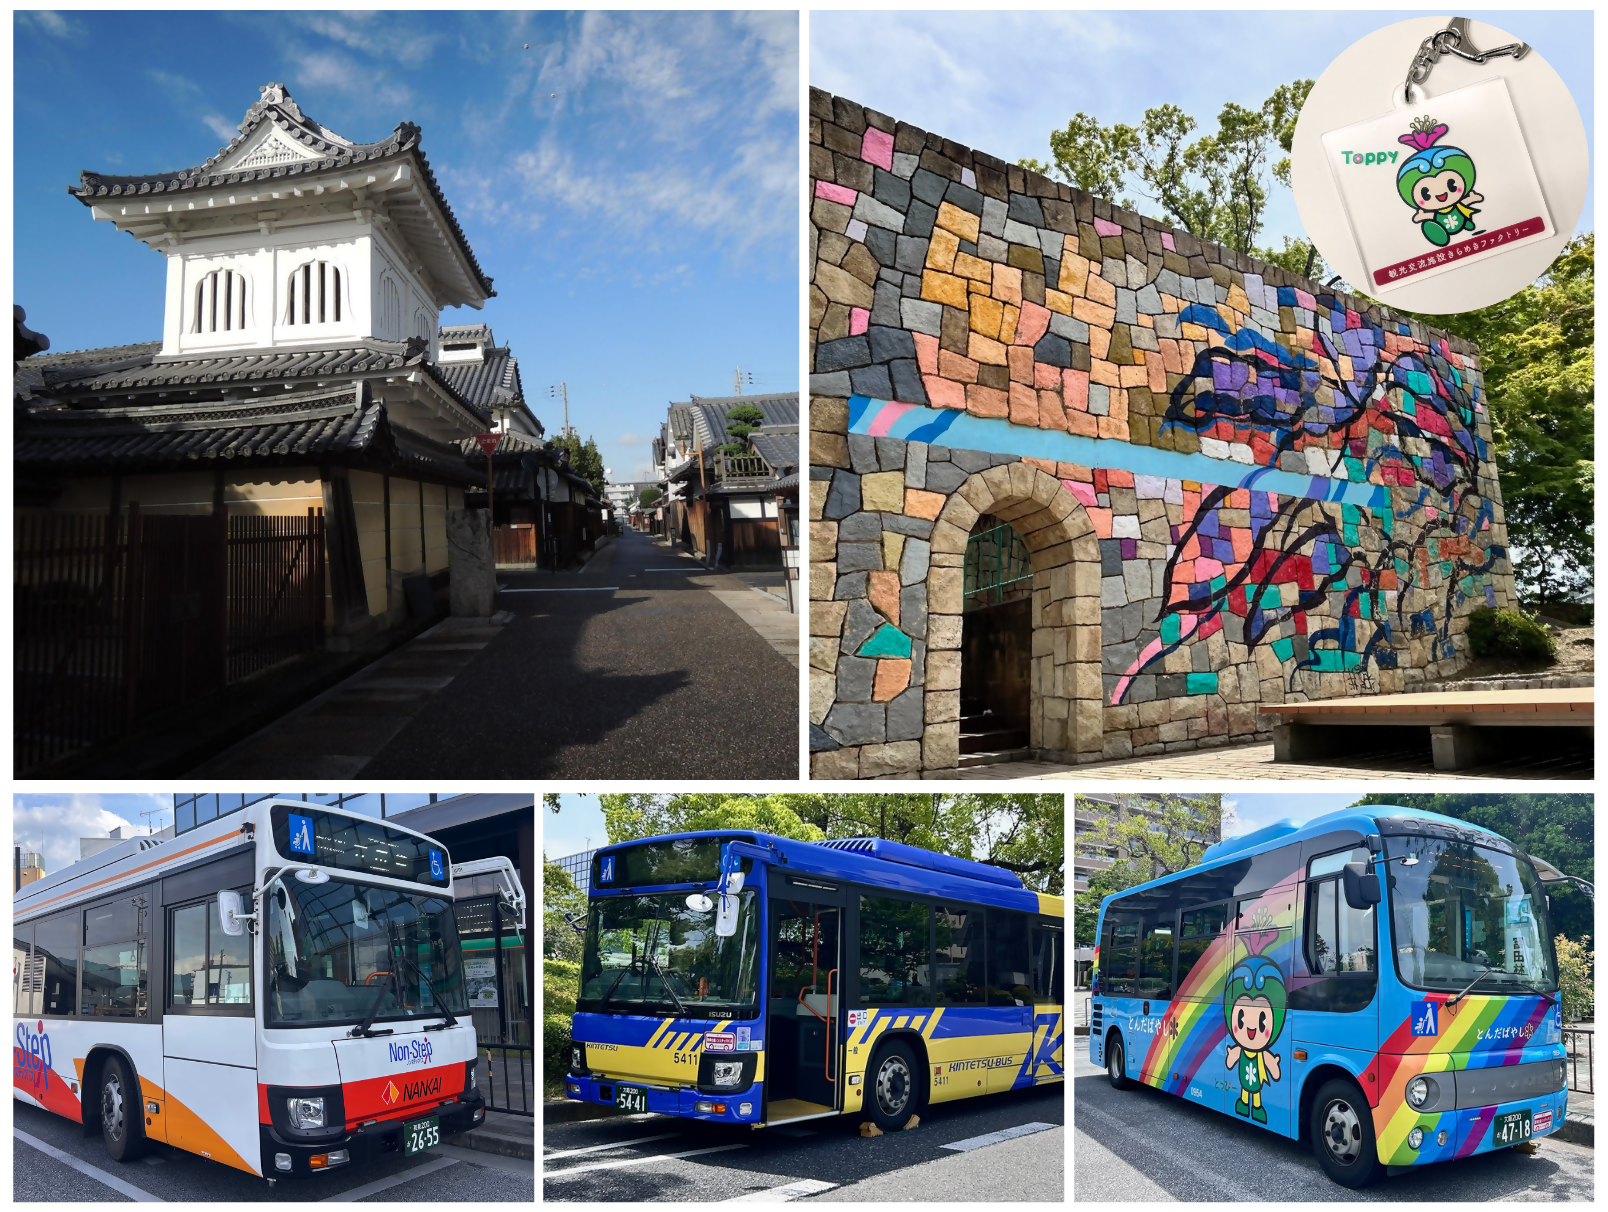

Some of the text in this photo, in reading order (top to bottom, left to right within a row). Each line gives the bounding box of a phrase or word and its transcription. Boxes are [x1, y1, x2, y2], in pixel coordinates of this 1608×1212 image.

[1341, 151, 1399, 166] Toppy
[1388, 227, 1529, 279] 観光交流施設きらめきファクトリー
[1128, 1016, 1169, 1037] とんだばやし
[1476, 1025, 1525, 1040] とんだばやし
[388, 1037, 433, 1064] Non-Step
[586, 1042, 619, 1052] KINTETSU
[673, 1052, 698, 1066] 5411
[933, 1076, 949, 1087] 5411
[403, 1077, 442, 1102] NANKAI
